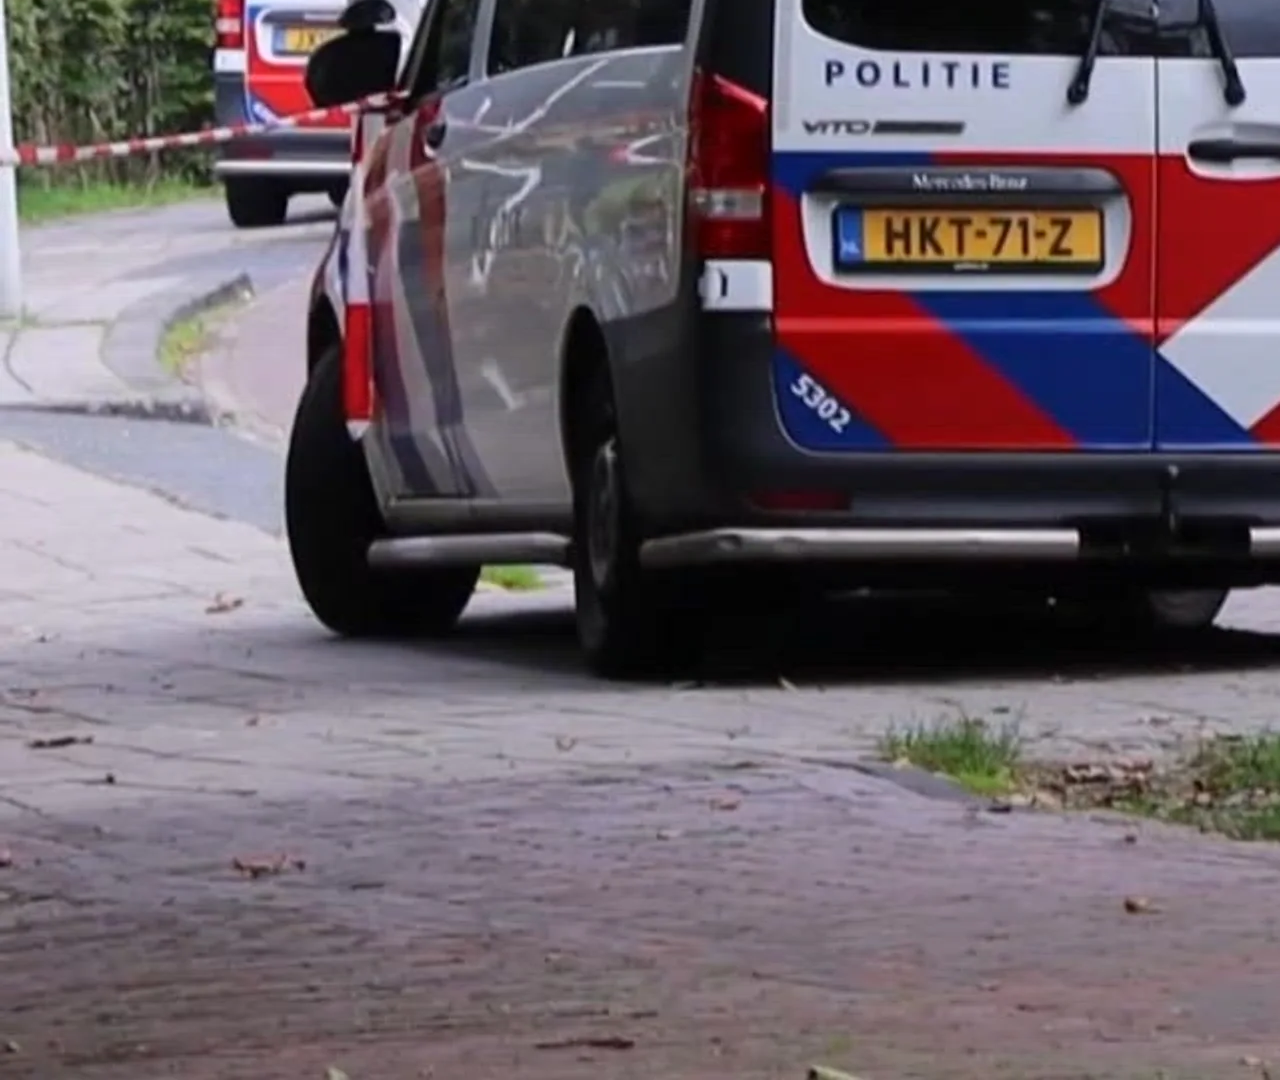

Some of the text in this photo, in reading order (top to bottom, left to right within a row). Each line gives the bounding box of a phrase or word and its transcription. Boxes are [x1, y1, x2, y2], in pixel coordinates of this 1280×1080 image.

[824, 60, 1012, 89] POLITIE
[802, 120, 871, 135] VITO
[883, 215, 1074, 257] HKT-71-Z
[789, 372, 852, 435] 5302
